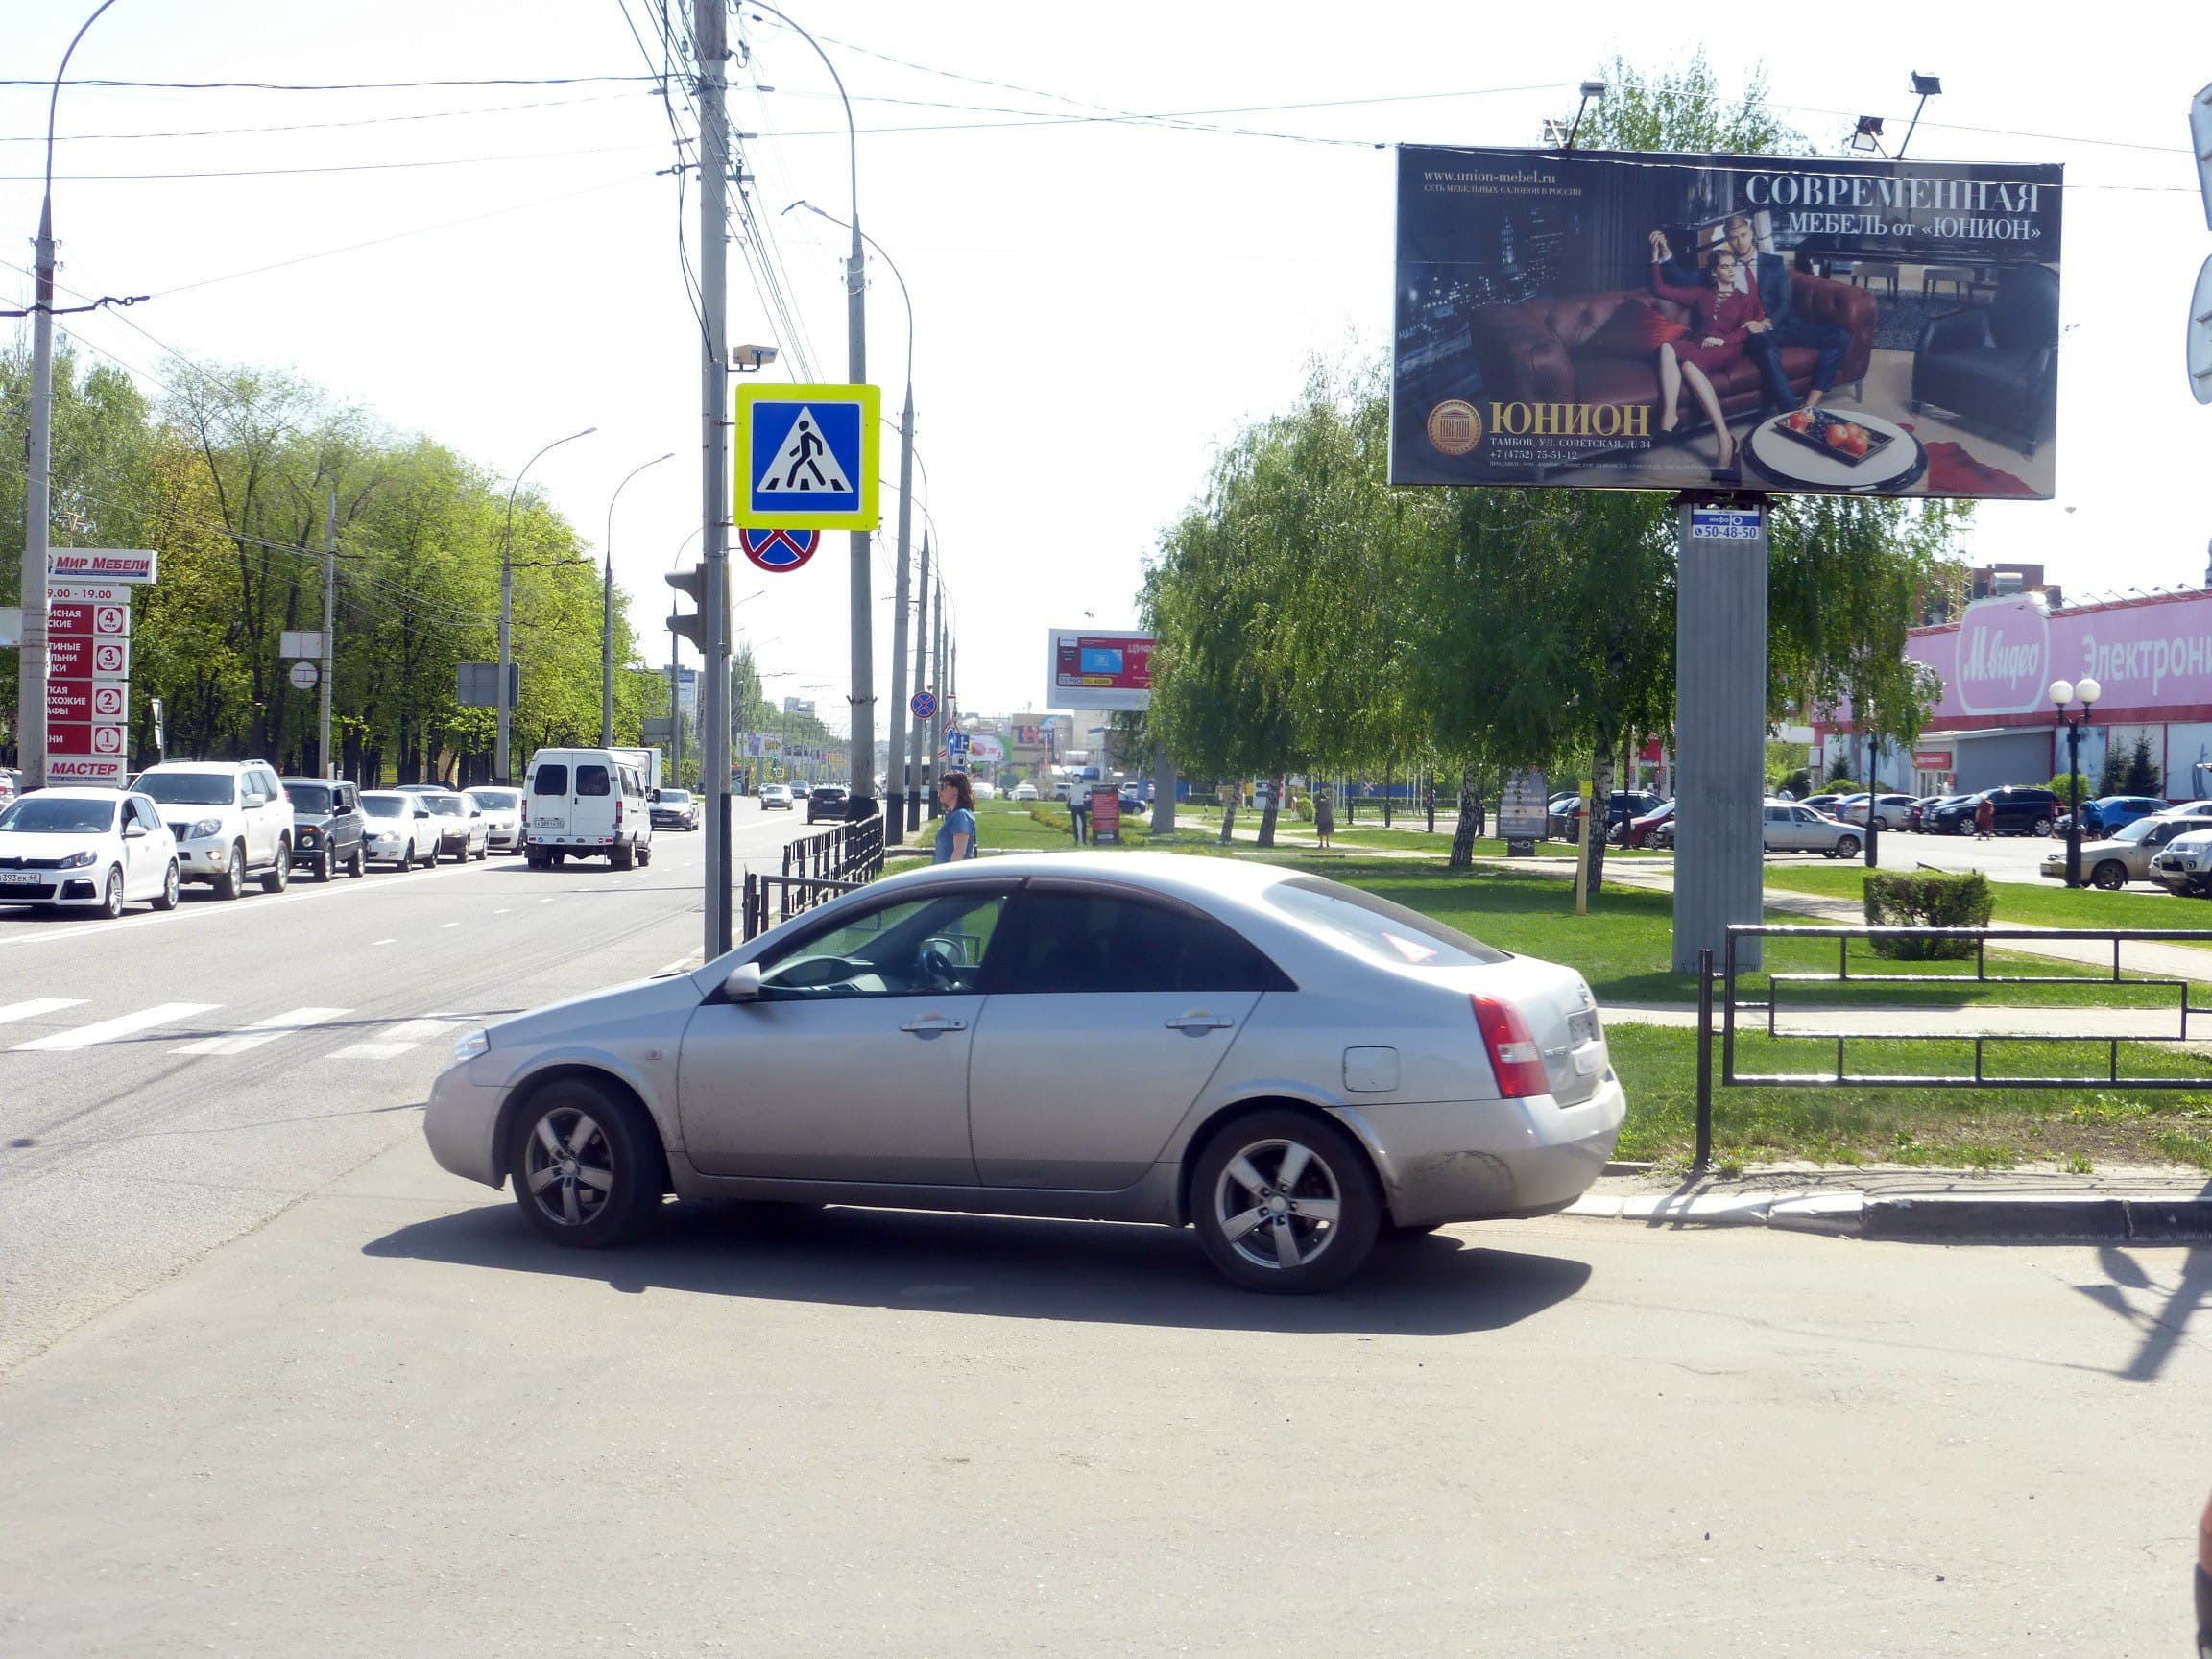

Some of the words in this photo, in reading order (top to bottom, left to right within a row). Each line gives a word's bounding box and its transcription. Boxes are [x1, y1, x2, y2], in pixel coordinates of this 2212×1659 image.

[1424, 169, 1556, 183] www.union-mebel.ru
[1745, 175, 2041, 213] СОВРЕМЕННАЯ
[1788, 212, 1888, 236] МЕБЕЛЬ
[1893, 222, 1916, 236] от
[1921, 216, 2042, 241] «ЮНИОН»
[1489, 401, 1652, 437] ЮНИОН
[1640, 440, 1652, 449] 34
[1489, 450, 1503, 459] +7
[1503, 450, 1534, 460] (4752)
[1537, 450, 1579, 460] 75-51-12
[1704, 526, 1757, 539] 50-48-50
[82, 589, 112, 599] 19.00
[104, 611, 115, 623] 4
[104, 649, 114, 661] 3
[104, 692, 113, 706] 2
[104, 731, 110, 743] 1
[51, 762, 118, 776] МАСТЕР
[0, 874, 27, 882] 393ЕК
